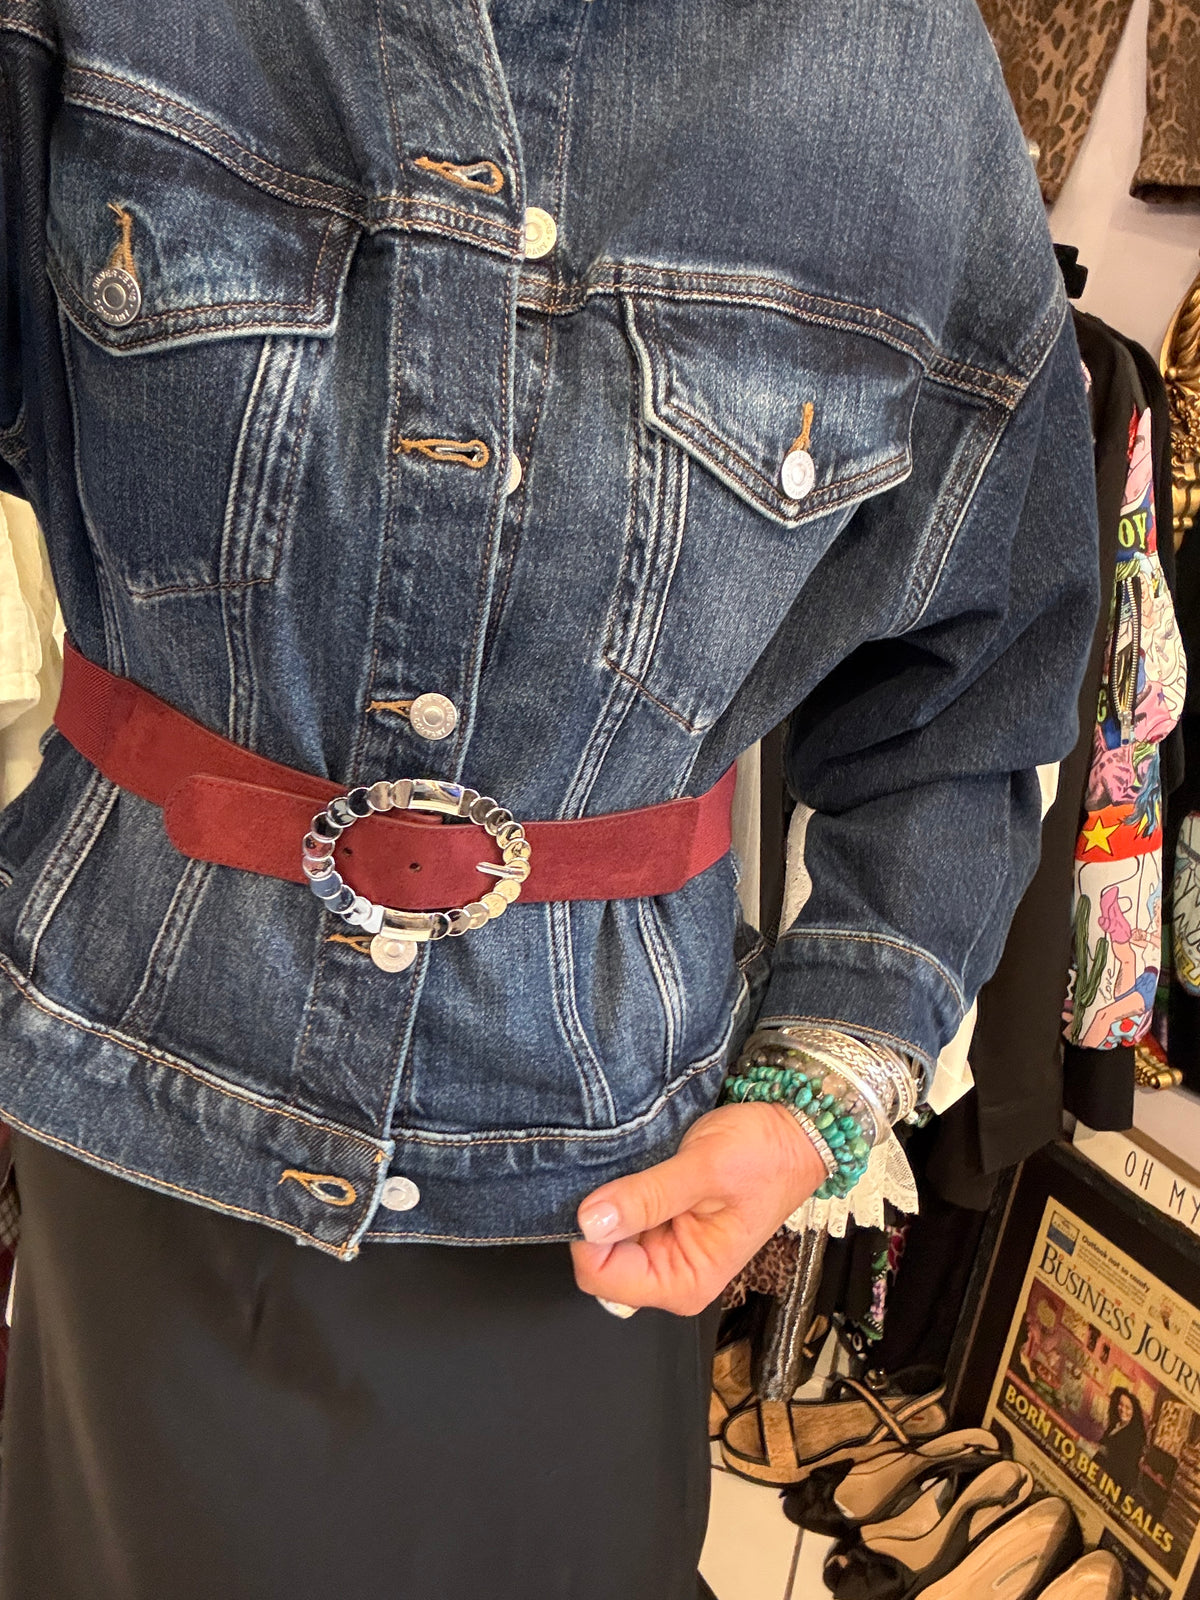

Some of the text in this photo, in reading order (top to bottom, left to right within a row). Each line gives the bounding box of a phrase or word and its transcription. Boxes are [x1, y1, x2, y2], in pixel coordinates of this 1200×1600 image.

[1124, 1150, 1200, 1225] OH MY
[1038, 1241, 1135, 1341] BUSINESS
[1081, 1235, 1108, 1258] Outlook
[1107, 1257, 1120, 1269] not
[1005, 1384, 1052, 1437] BORN
[1054, 1428, 1076, 1459] TO
[1077, 1452, 1100, 1482] BE
[1099, 1472, 1122, 1503] IN
[1121, 1495, 1174, 1553] SALES
